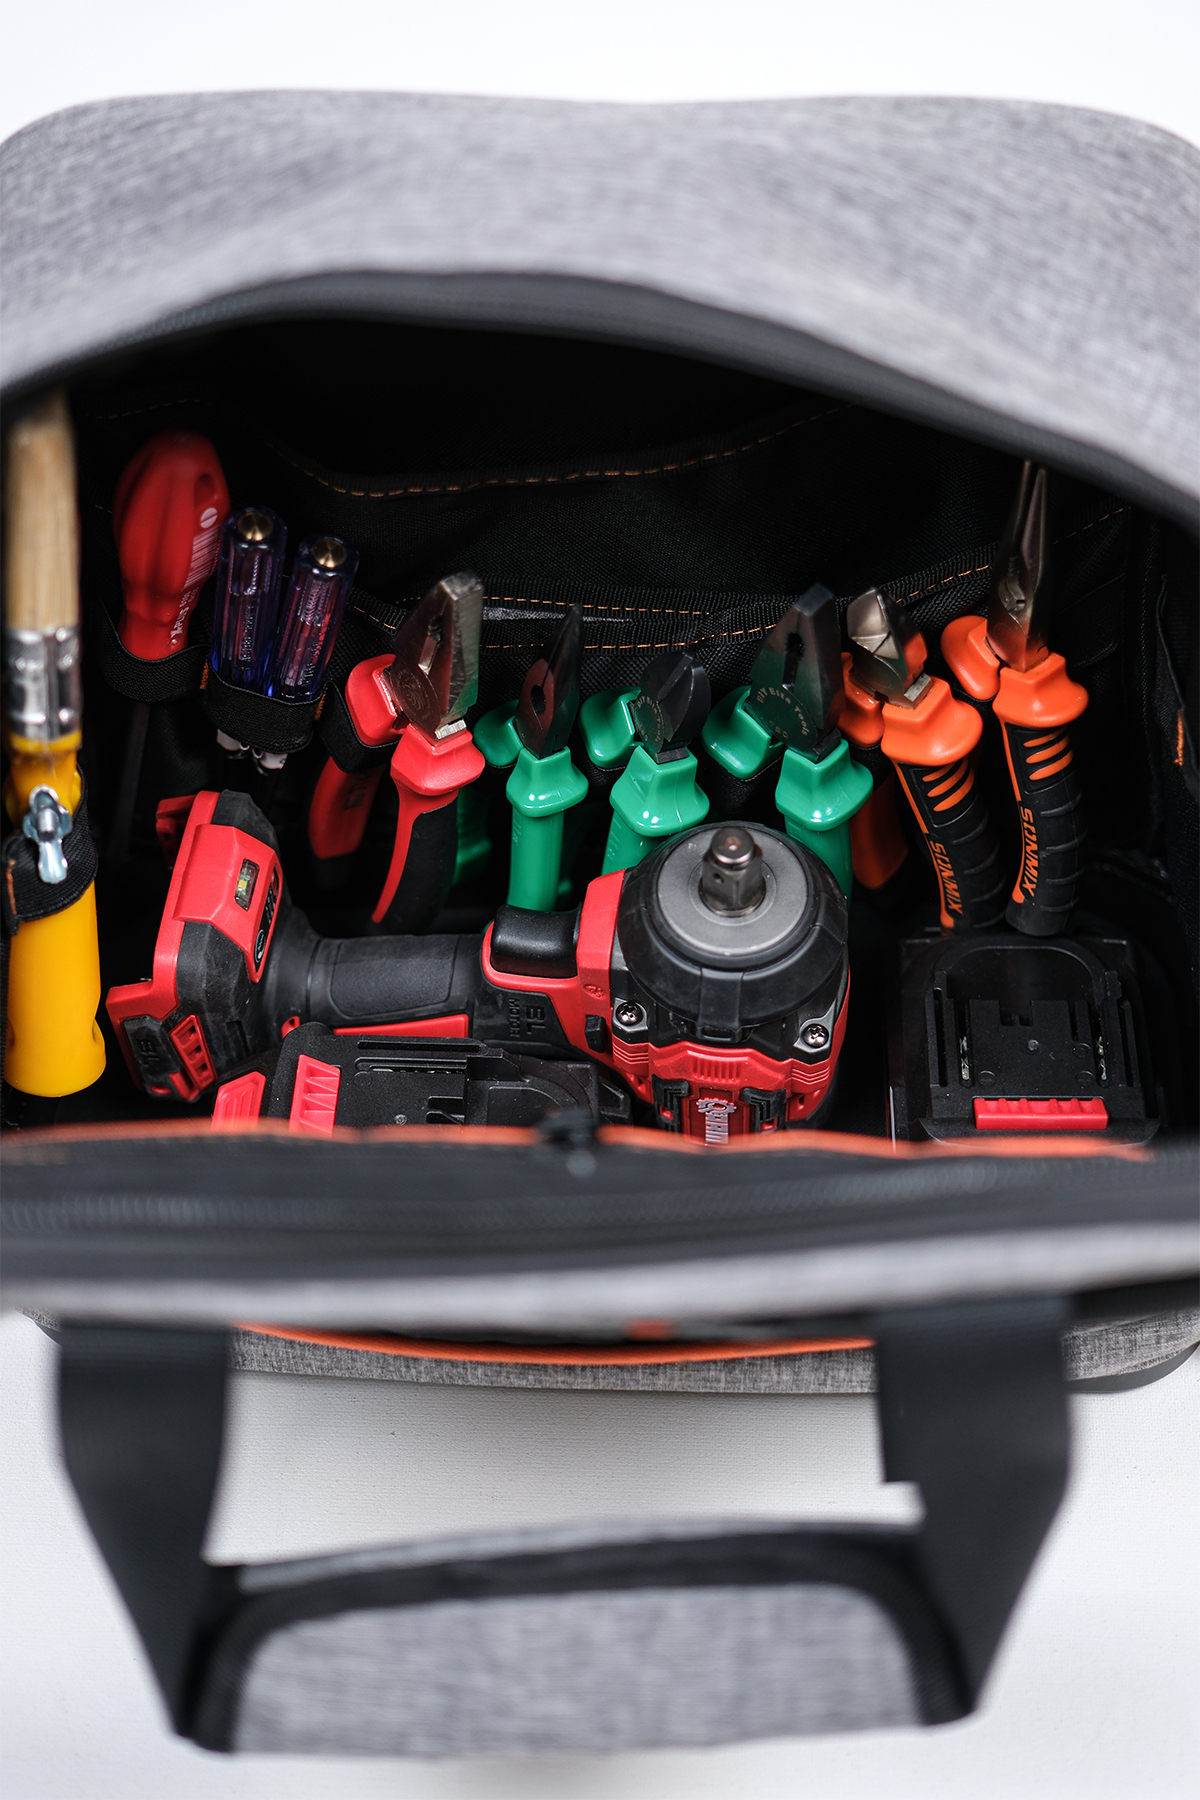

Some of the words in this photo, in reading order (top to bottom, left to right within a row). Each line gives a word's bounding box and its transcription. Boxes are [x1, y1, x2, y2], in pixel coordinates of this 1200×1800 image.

[756, 687, 768, 704] DIY
[794, 705, 810, 737] Tools
[508, 998, 520, 1038] MOTOR
[525, 1005, 546, 1035] BL
